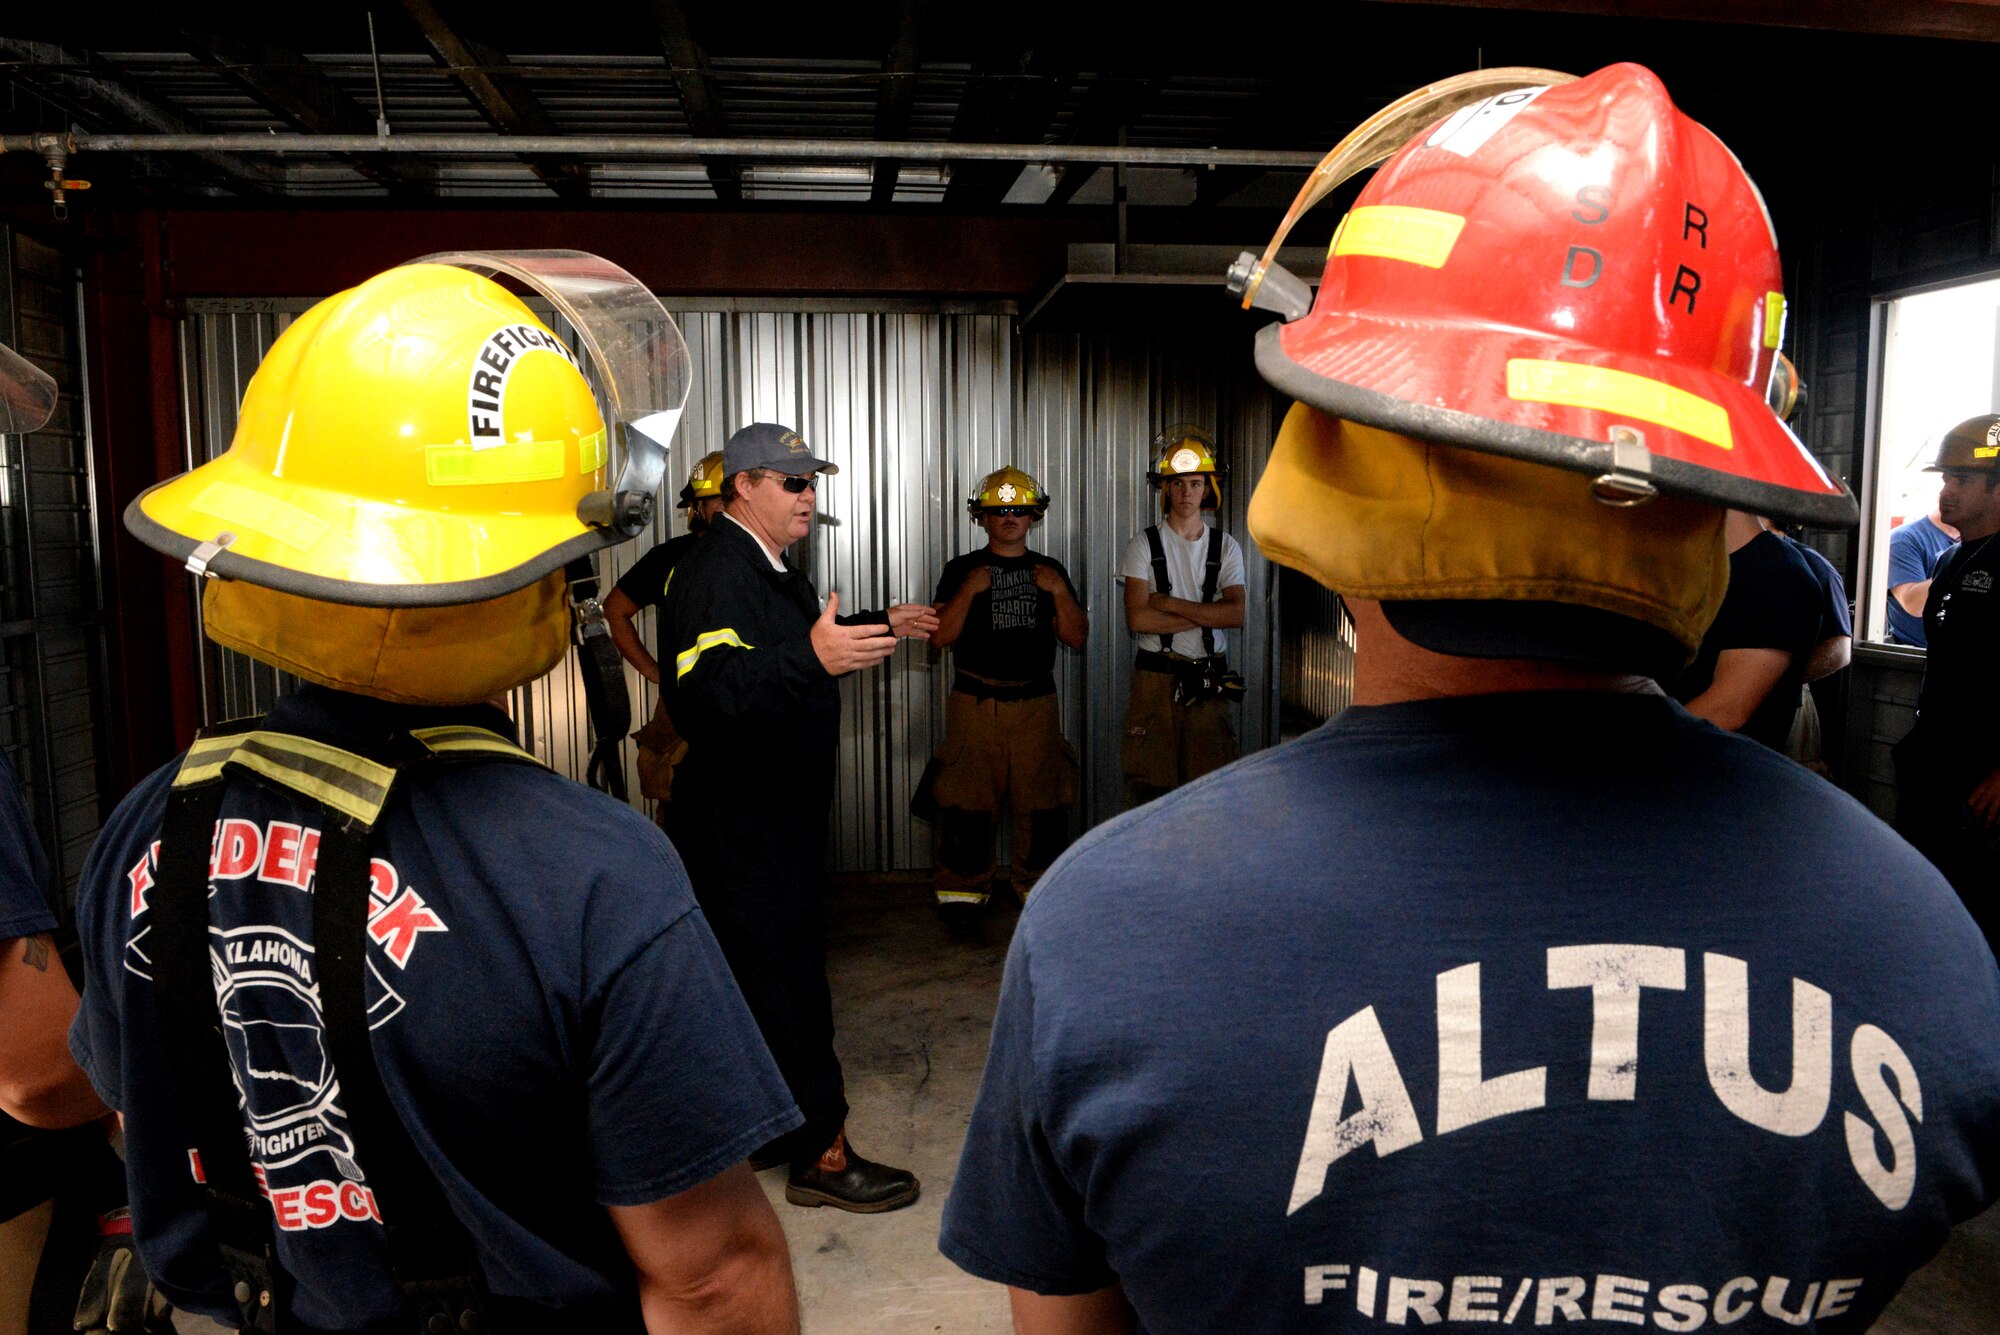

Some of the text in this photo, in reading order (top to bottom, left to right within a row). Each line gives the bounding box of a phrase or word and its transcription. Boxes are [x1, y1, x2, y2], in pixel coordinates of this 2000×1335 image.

[1573, 186, 1709, 249] S R
[1564, 245, 1702, 314] D R
[992, 569, 1032, 590] DRINKIN
[992, 583, 1037, 600] ORGANIZATION
[992, 601, 1037, 616] CHARITY
[993, 613, 1035, 630] PROBLEM
[127, 818, 449, 970] FDERCK
[224, 939, 312, 984] KLAHOMA
[1286, 943, 1923, 1217] ALTUS
[1304, 1264, 1863, 1332] FIRE/RESCUE
